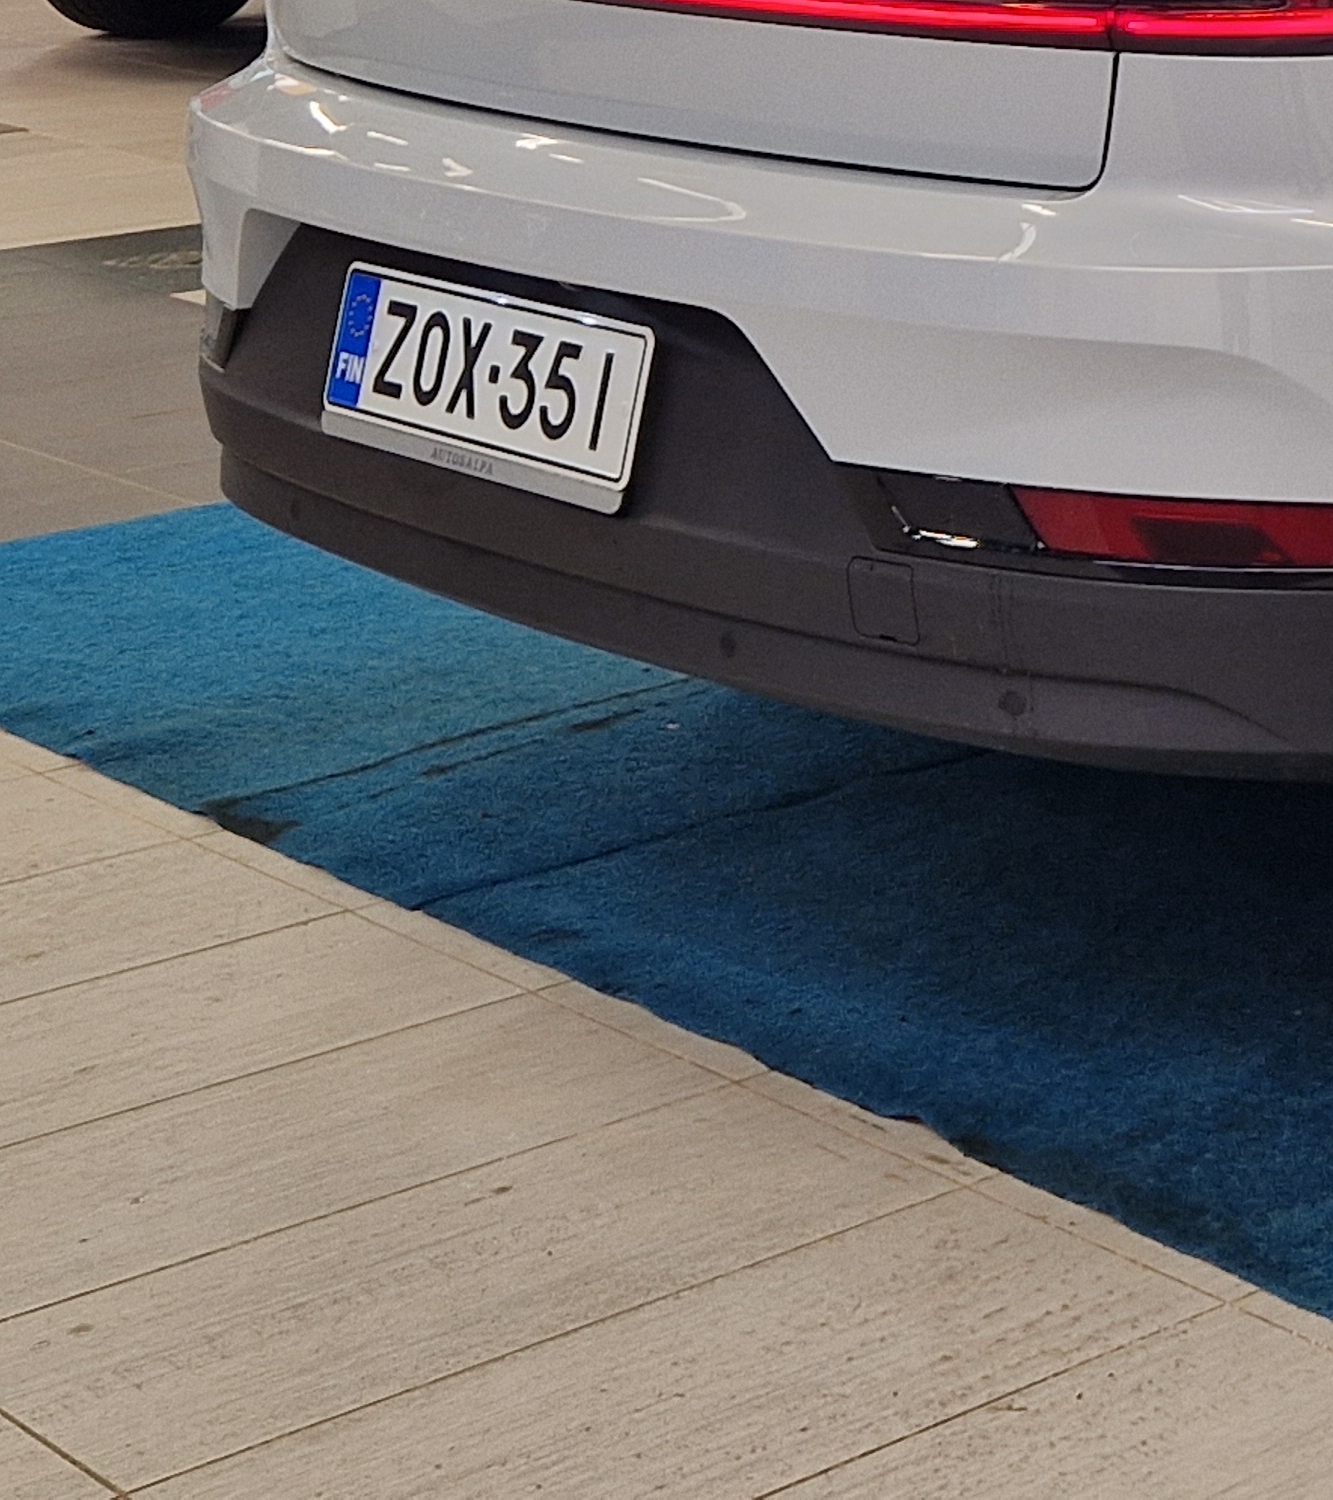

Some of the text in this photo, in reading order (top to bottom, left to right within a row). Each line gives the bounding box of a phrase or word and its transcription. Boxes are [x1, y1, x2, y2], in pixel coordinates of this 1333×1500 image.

[336, 352, 366, 383] FIN
[372, 300, 614, 451] ZOX-351
[430, 447, 493, 475] AUTOSALPA
